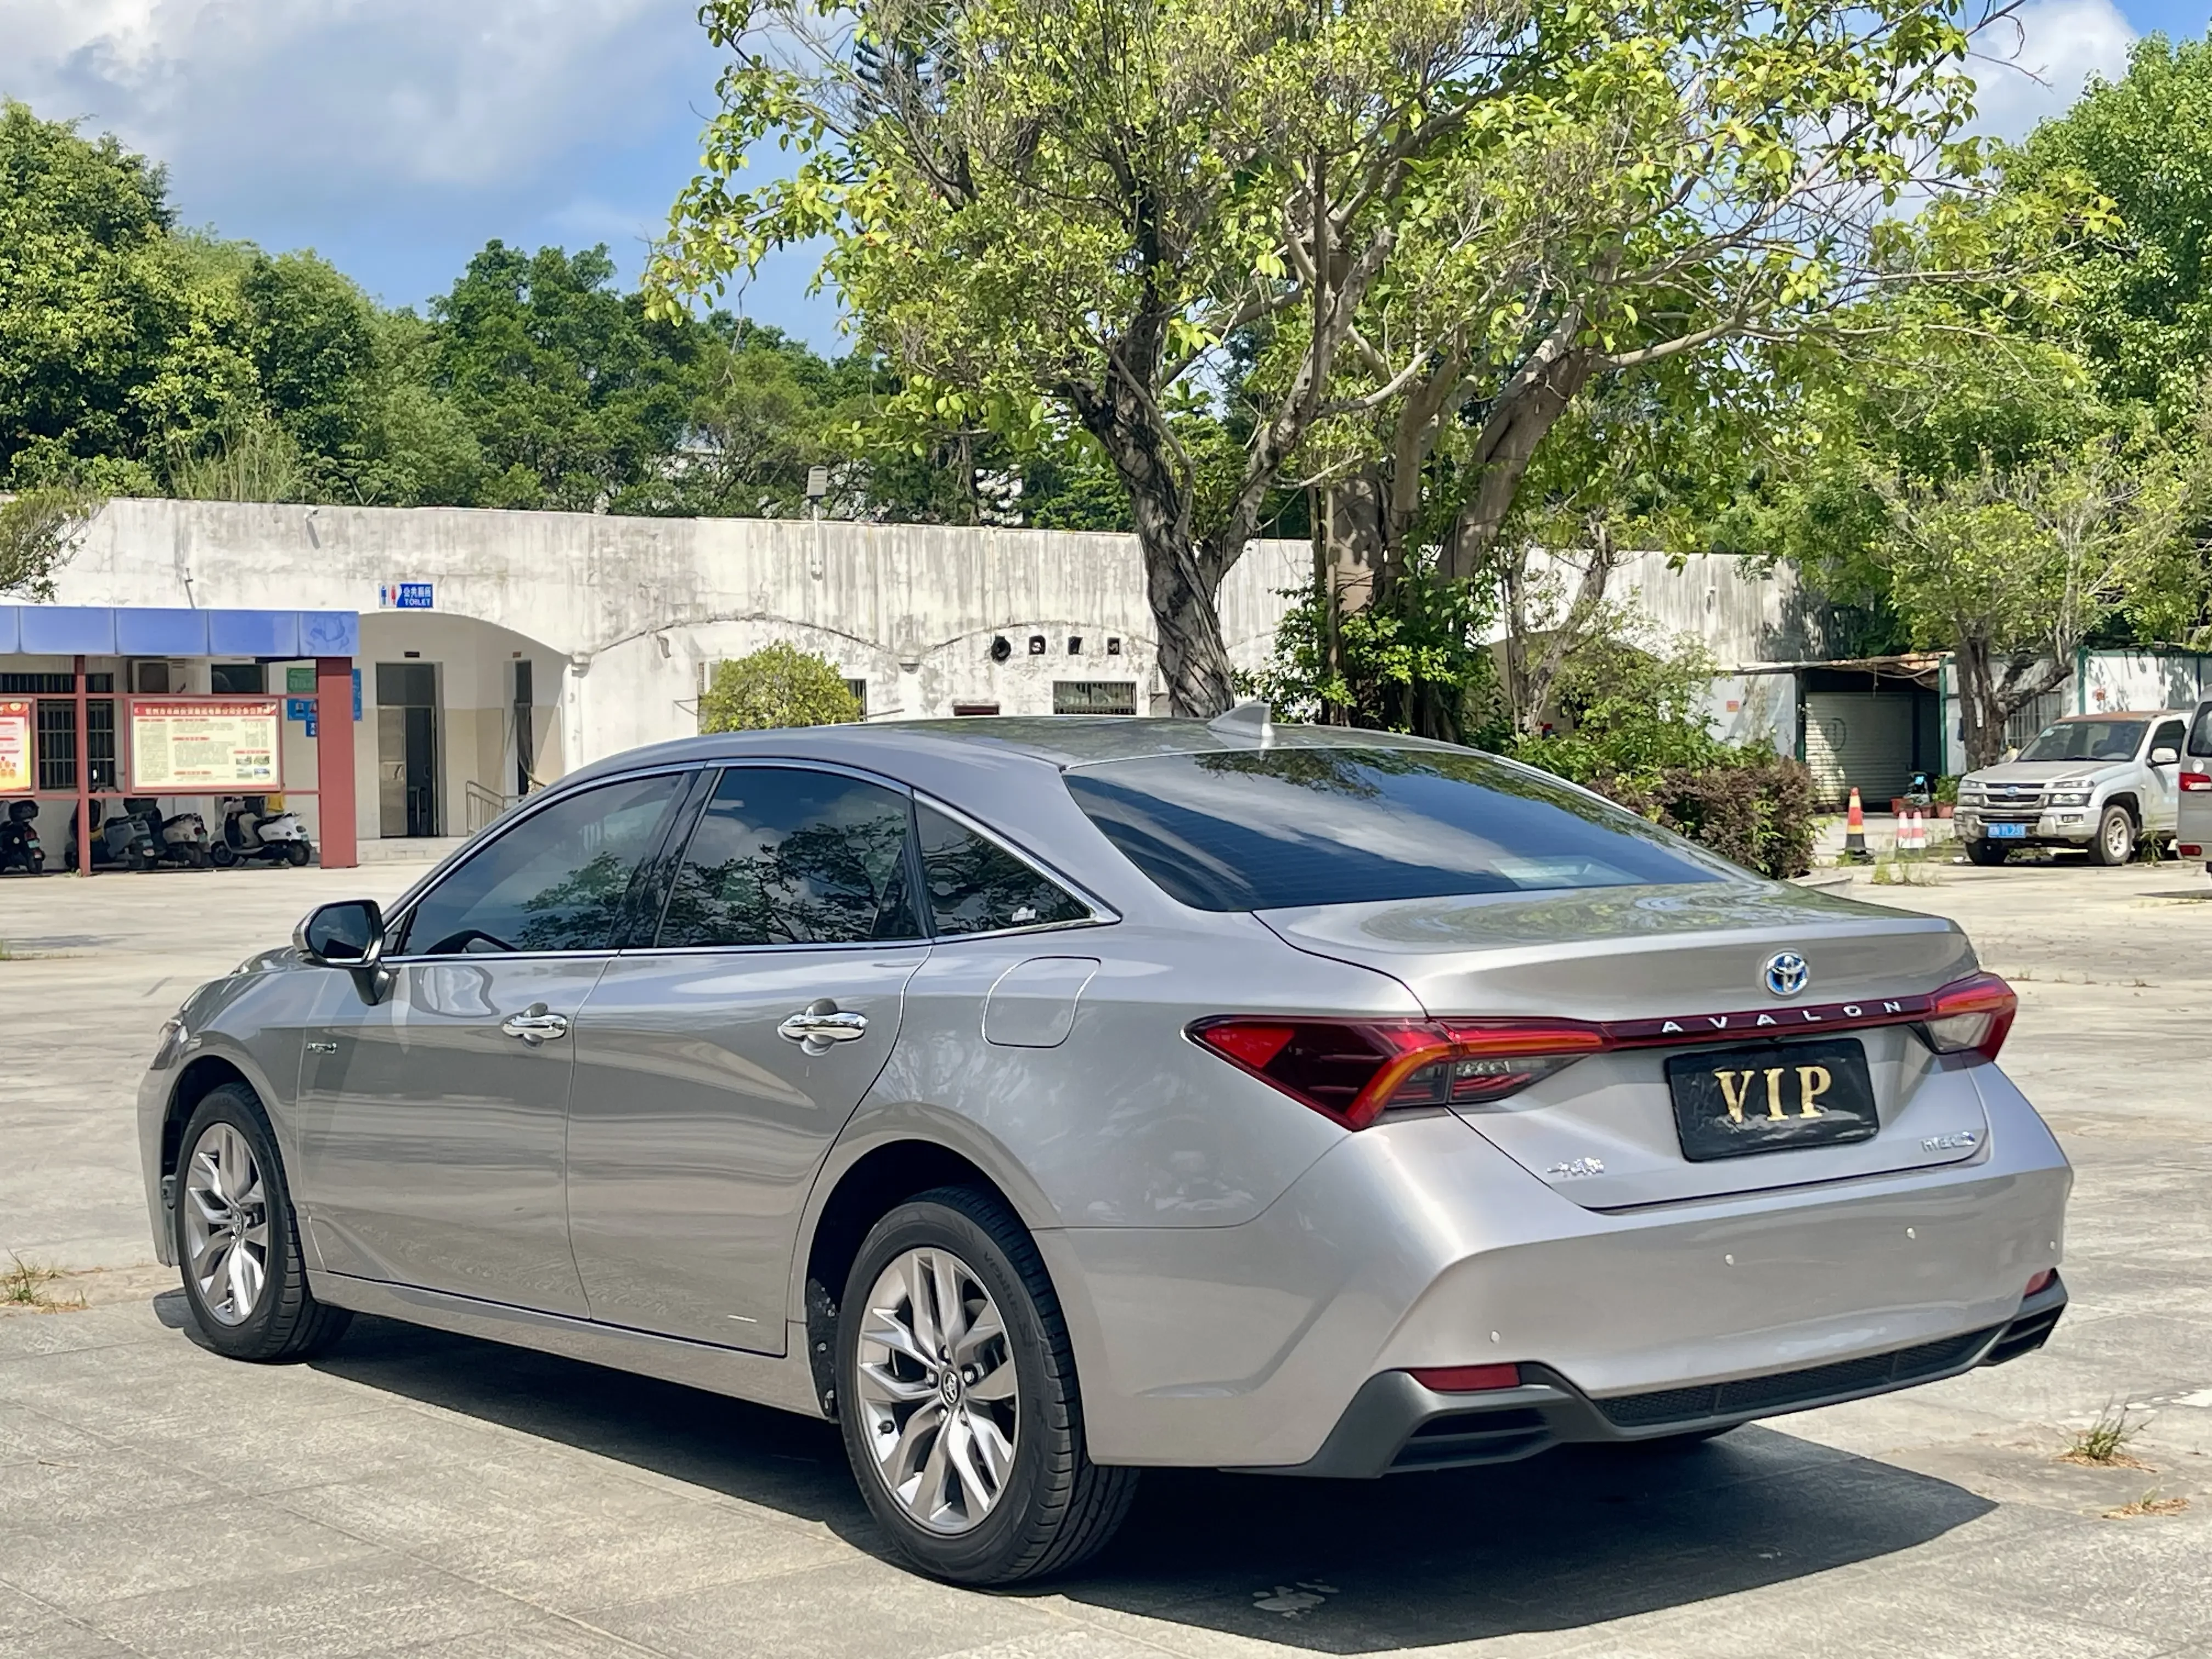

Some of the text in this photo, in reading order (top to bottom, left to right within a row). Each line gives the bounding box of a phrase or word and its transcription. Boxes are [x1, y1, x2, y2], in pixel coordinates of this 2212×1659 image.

[404, 598, 431, 606] TOILET
[1661, 1001, 1902, 1034] AVALON
[1714, 1065, 1832, 1124] VIP
